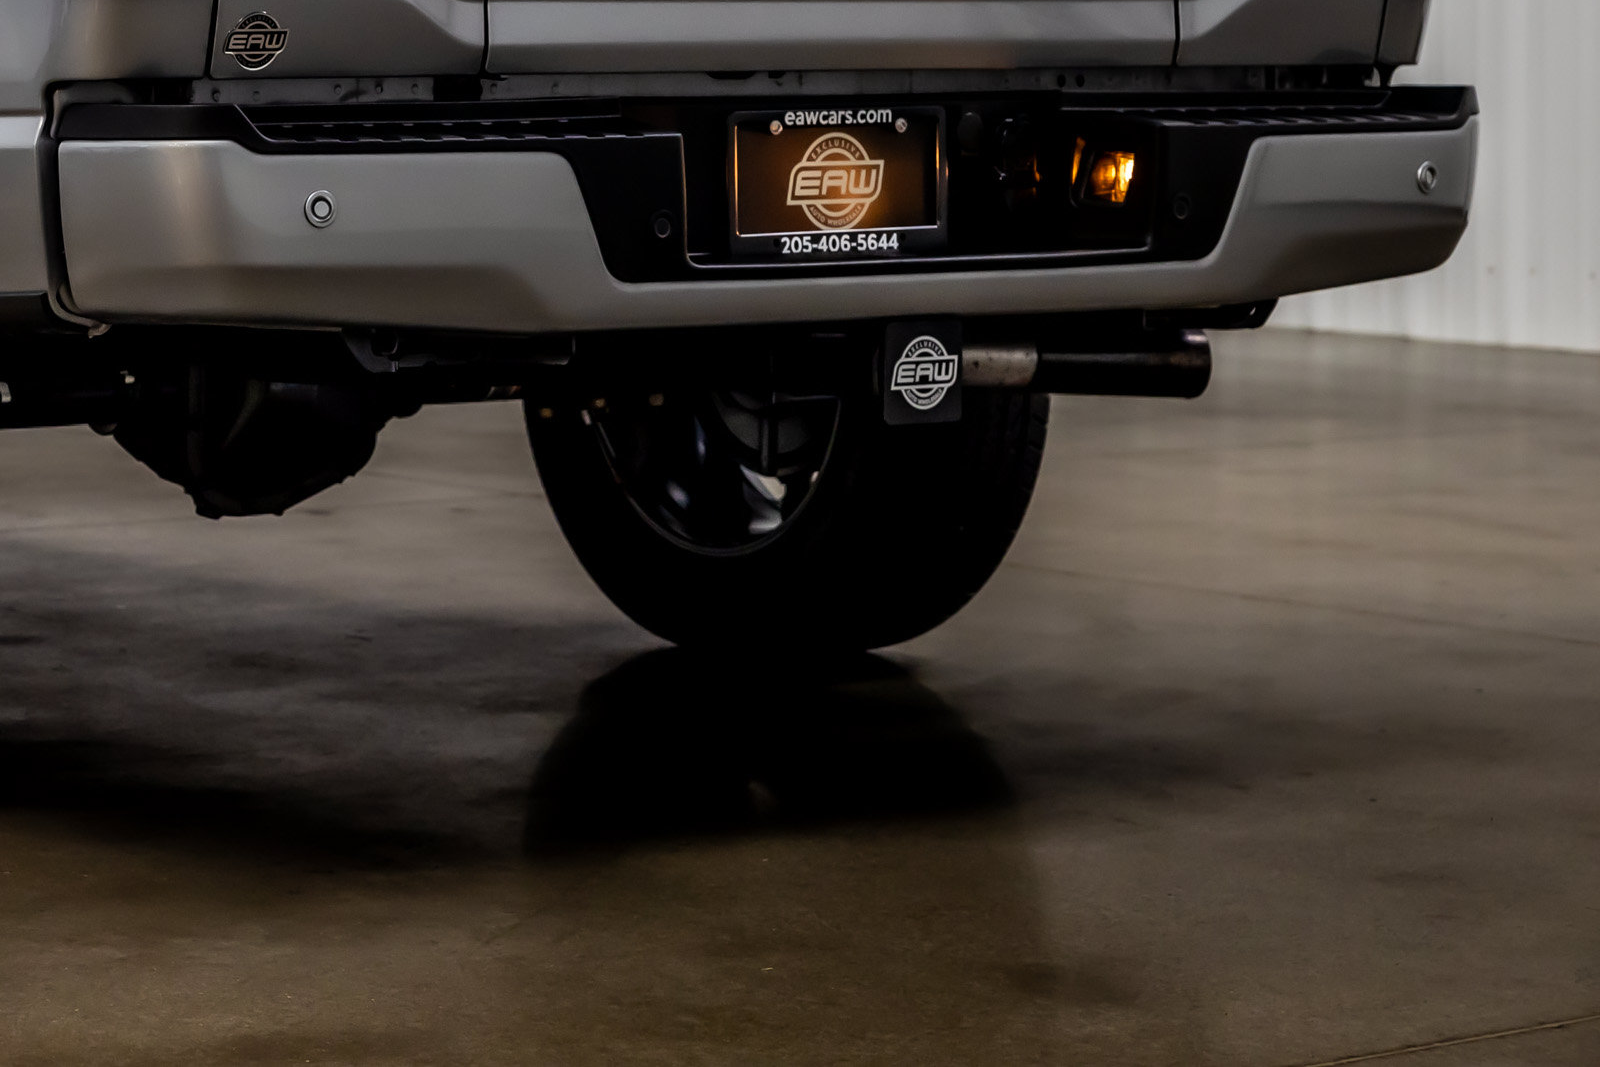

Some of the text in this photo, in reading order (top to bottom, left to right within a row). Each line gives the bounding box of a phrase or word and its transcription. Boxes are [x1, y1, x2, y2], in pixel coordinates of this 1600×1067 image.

[228, 33, 285, 50] EAW
[784, 108, 893, 126] eawcars.com
[811, 138, 861, 160] EXCLUSIVE
[794, 168, 877, 197] EAW
[780, 232, 899, 254] 205-406-5644
[896, 362, 954, 384] EAW
